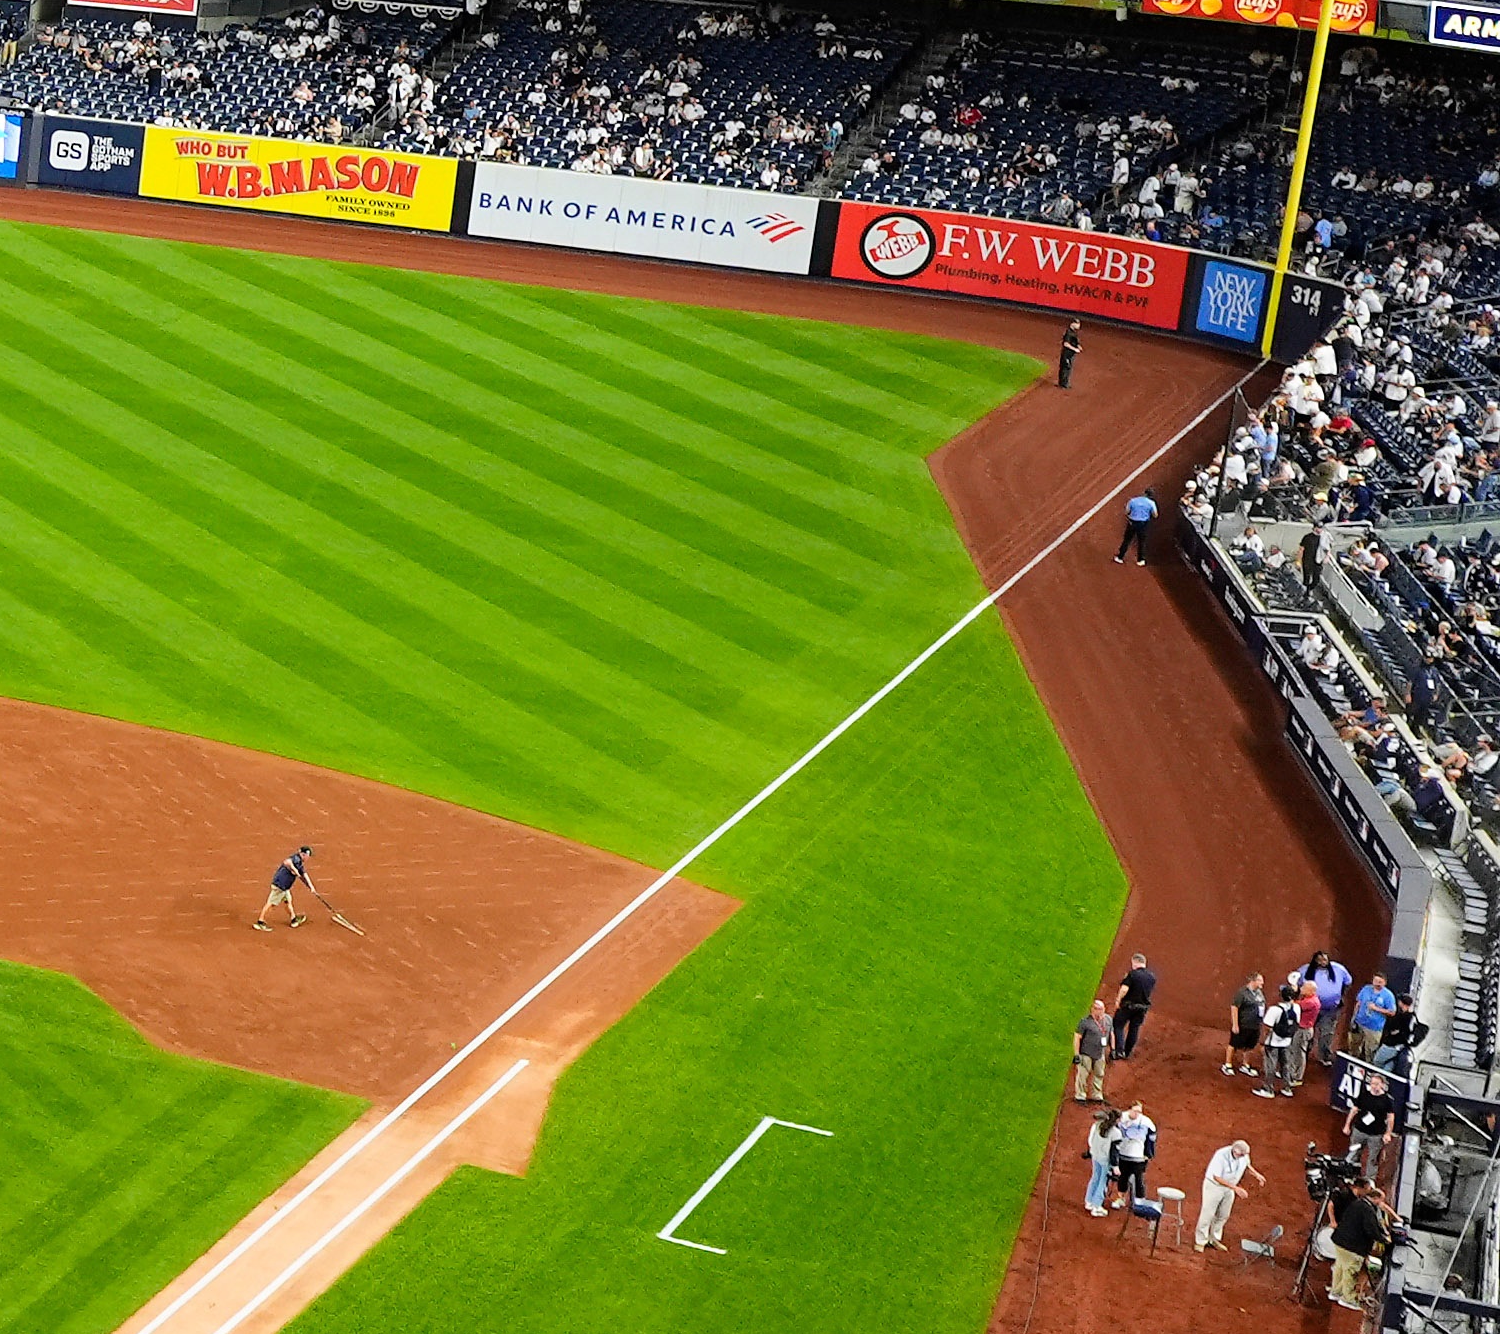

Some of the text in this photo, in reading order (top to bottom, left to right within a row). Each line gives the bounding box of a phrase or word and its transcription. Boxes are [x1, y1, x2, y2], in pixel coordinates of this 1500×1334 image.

[92, 136, 114, 147] THE
[175, 140, 248, 159] WHO BUT
[479, 192, 736, 238] BANK OF AMERICA
[1030, 236, 1156, 288] WEBB
[1215, 271, 1256, 293] NEW
[1291, 285, 1321, 307] 314
